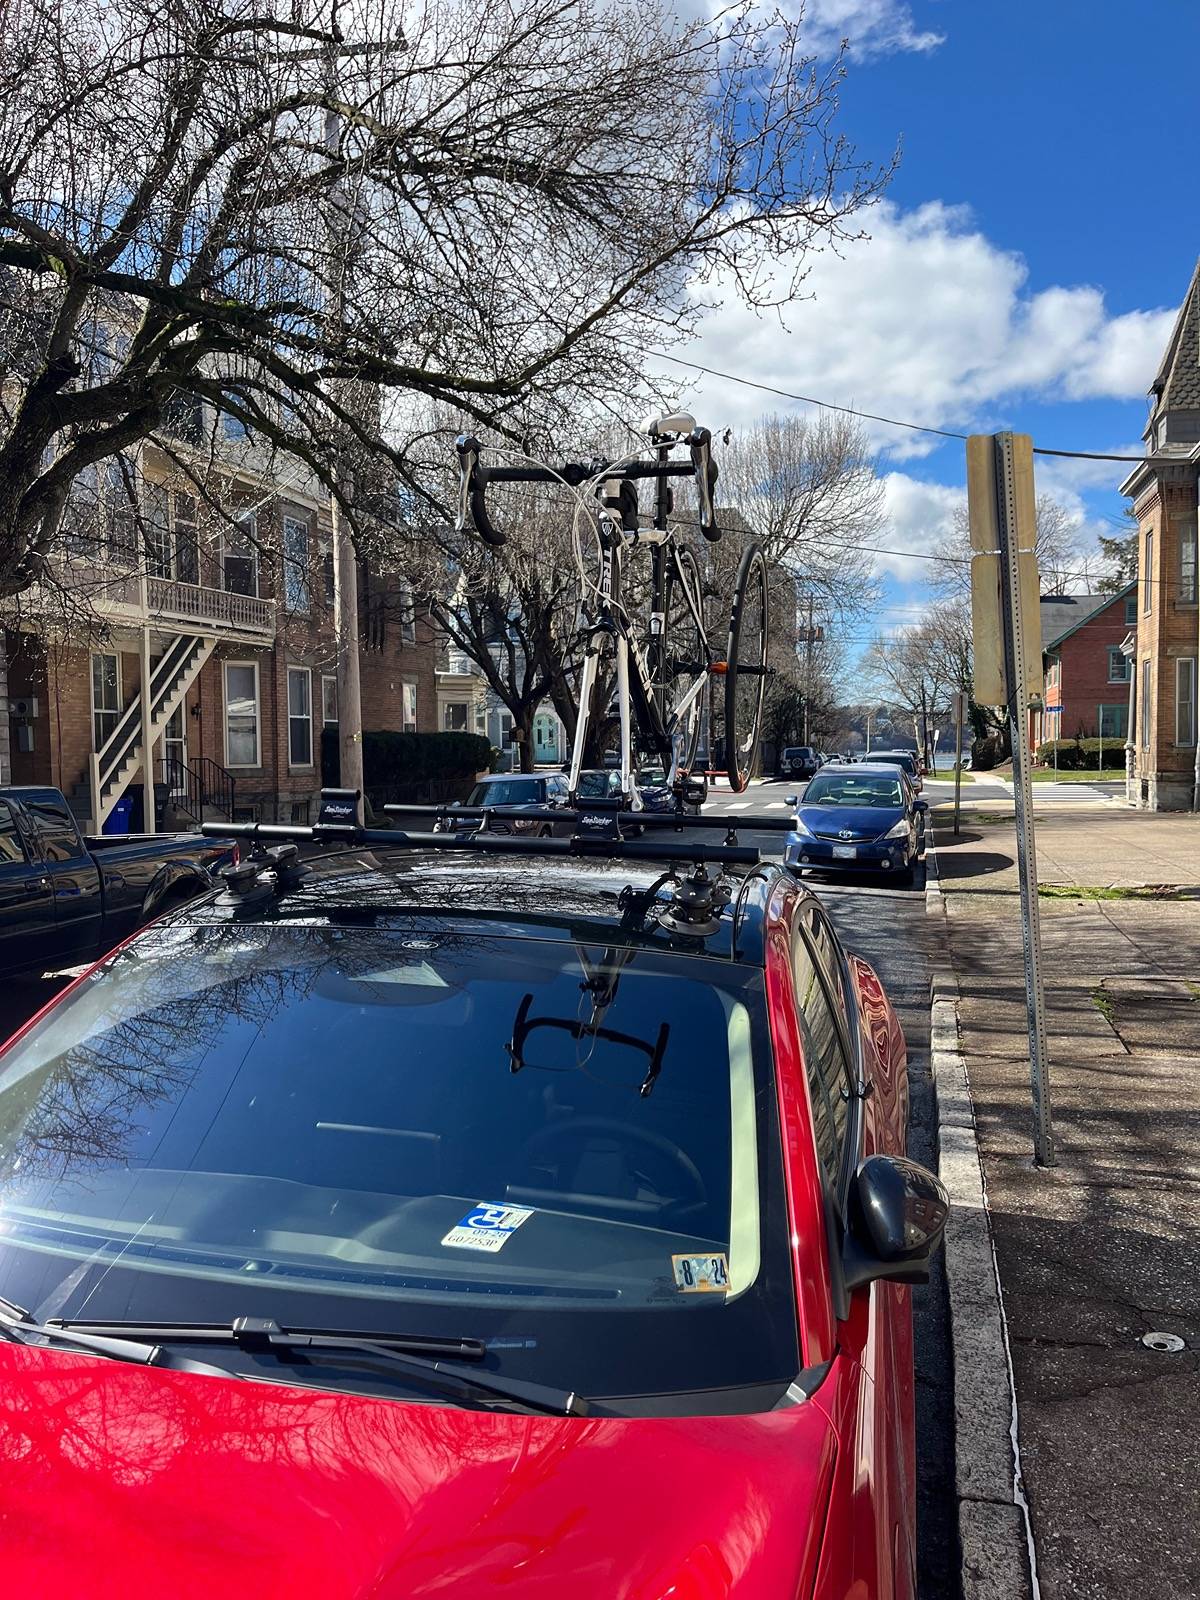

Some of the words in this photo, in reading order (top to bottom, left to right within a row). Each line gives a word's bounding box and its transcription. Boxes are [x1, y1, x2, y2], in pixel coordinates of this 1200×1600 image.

[602, 546, 613, 610] TREK
[681, 1259, 694, 1286] 8
[711, 1258, 728, 1284] 24
